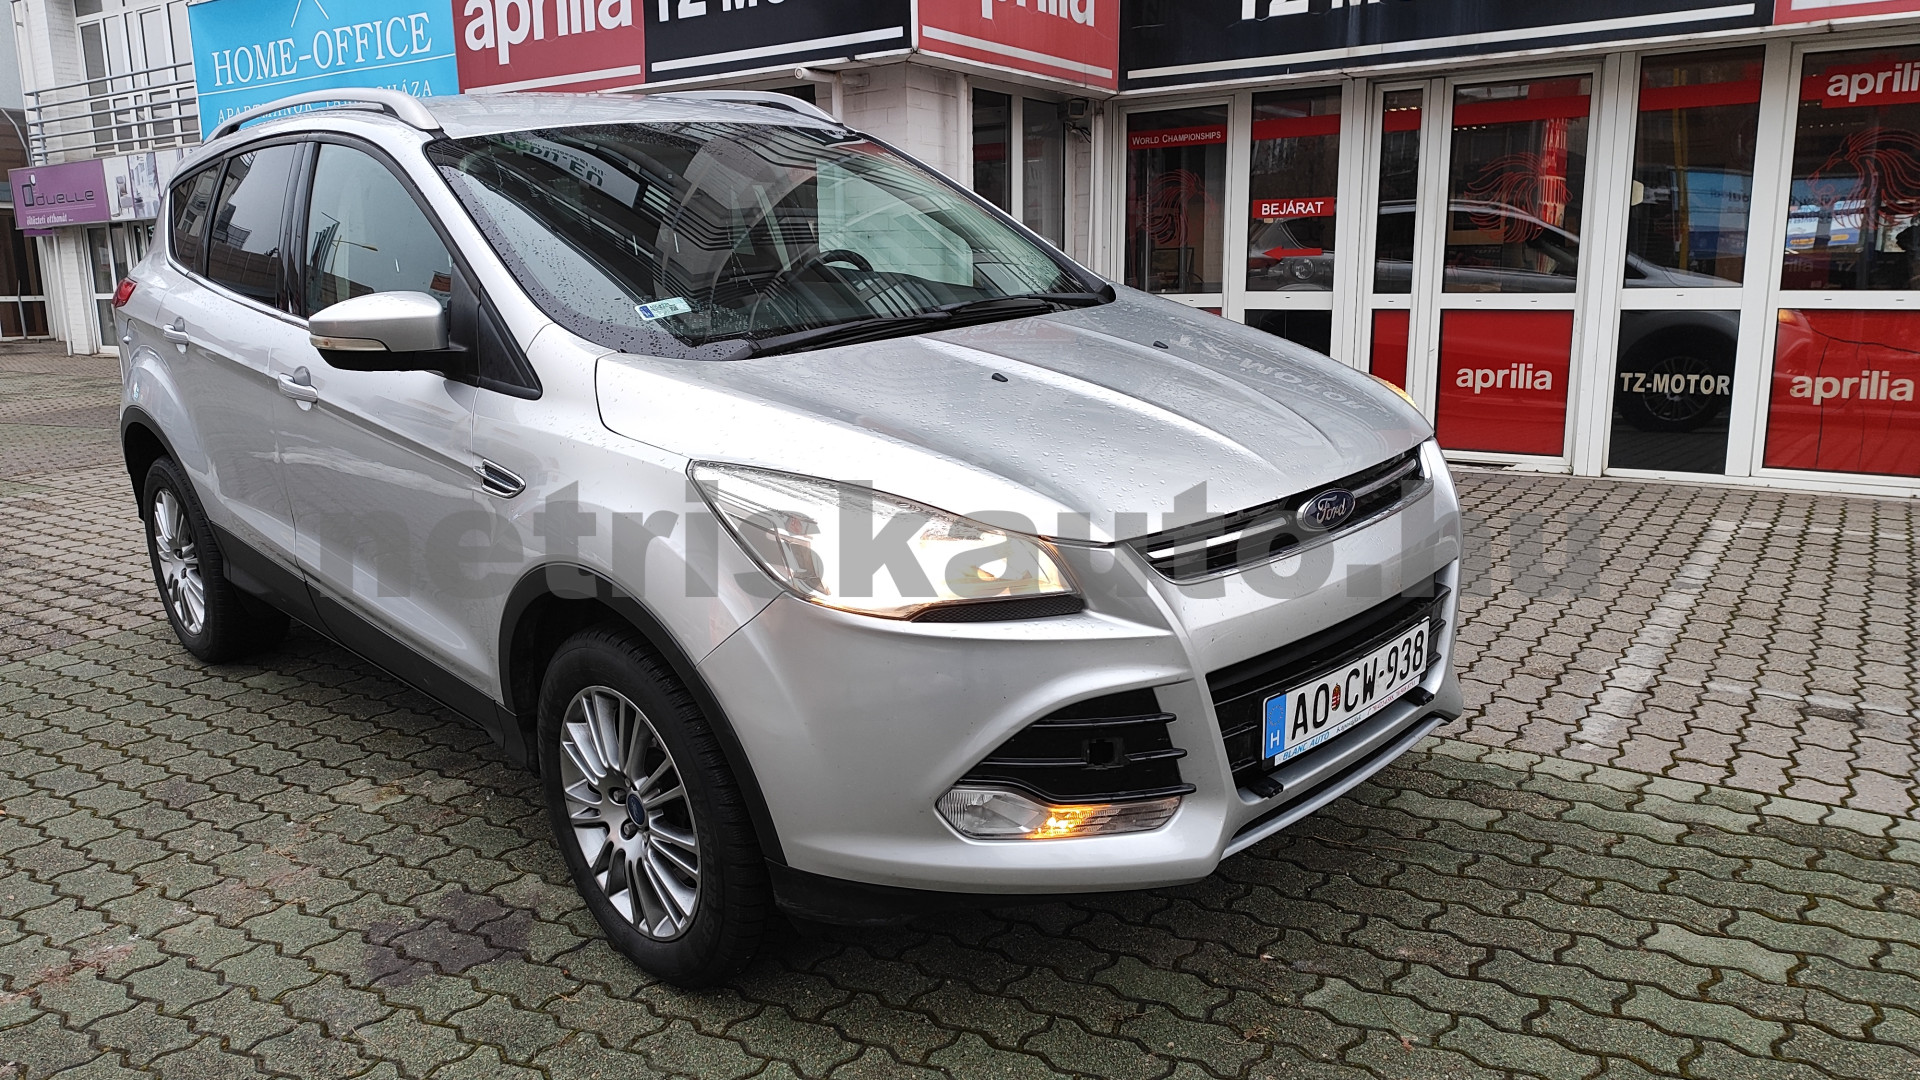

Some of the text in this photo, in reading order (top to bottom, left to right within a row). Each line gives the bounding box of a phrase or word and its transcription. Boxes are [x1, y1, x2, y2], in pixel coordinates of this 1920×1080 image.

[211, 11, 432, 87] HOME-OFFICE
[1826, 62, 1920, 103] aprili
[1261, 200, 1325, 216] BEJÁRAT
[1455, 363, 1553, 394] aprilia
[1620, 372, 1731, 395] TZ-MOTOR
[1789, 370, 1915, 406] aprilia
[1316, 495, 1347, 523] Ford
[1270, 729, 1280, 749] H
[1291, 683, 1330, 741] AO
[1344, 630, 1425, 712] CW-938
[1309, 731, 1330, 748] AUTO
